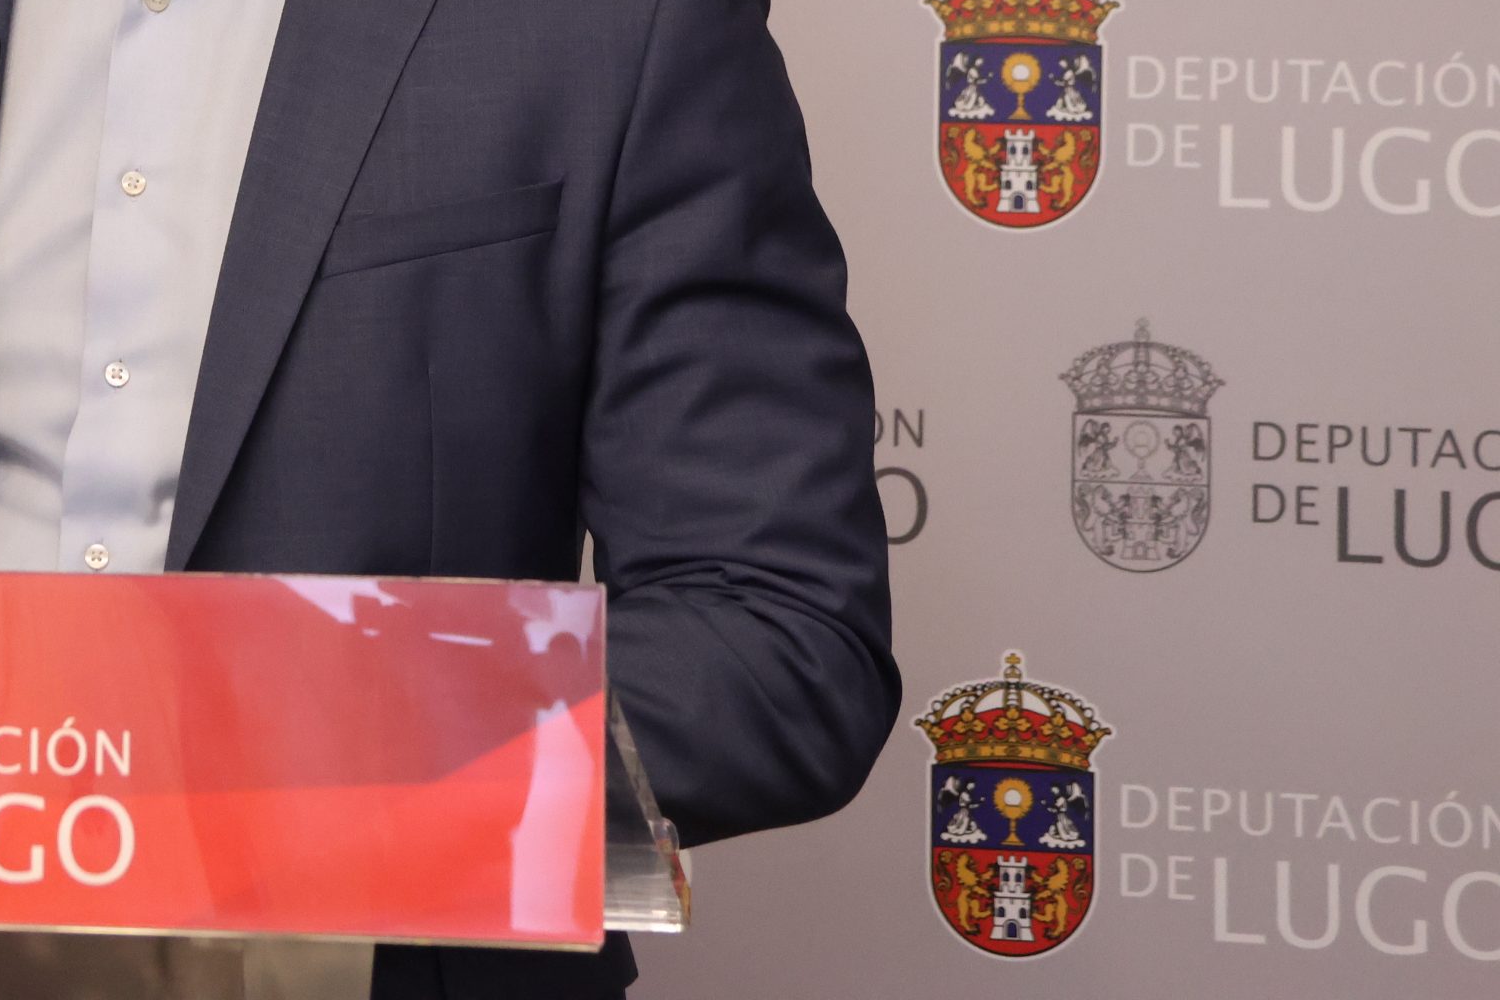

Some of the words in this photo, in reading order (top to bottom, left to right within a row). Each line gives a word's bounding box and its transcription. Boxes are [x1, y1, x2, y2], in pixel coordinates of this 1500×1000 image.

[1126, 122, 1200, 168] DE
[1252, 483, 1320, 526] DE
[1120, 852, 1195, 901] DE
